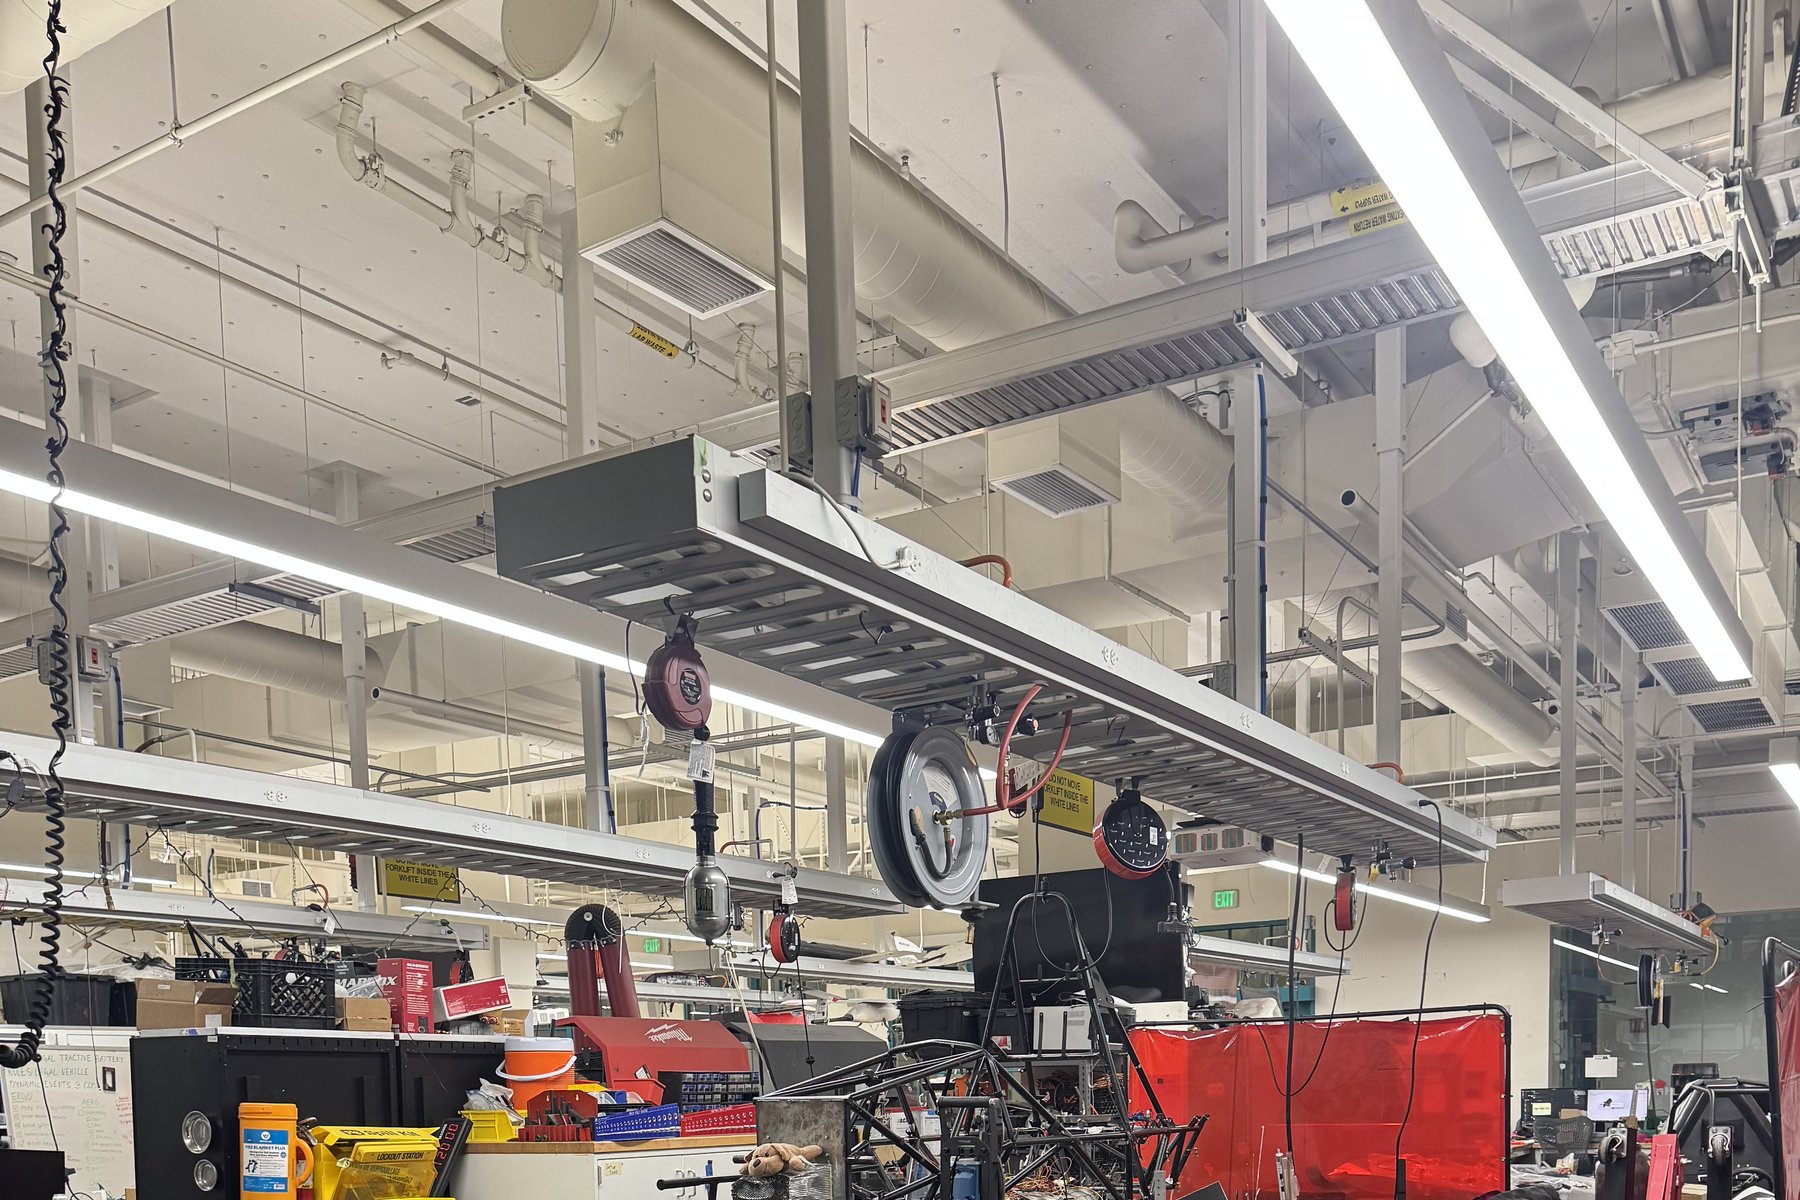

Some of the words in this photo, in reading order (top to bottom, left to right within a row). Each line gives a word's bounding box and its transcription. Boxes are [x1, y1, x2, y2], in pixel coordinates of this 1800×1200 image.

[644, 338, 667, 354] WASTE
[385, 863, 415, 875] FORKLIFT
[416, 867, 437, 877] INSIDE
[398, 873, 420, 883] WHITE
[420, 876, 439, 886] LINES
[1214, 890, 1235, 909] EXIT
[401, 1151, 424, 1160] STATION
